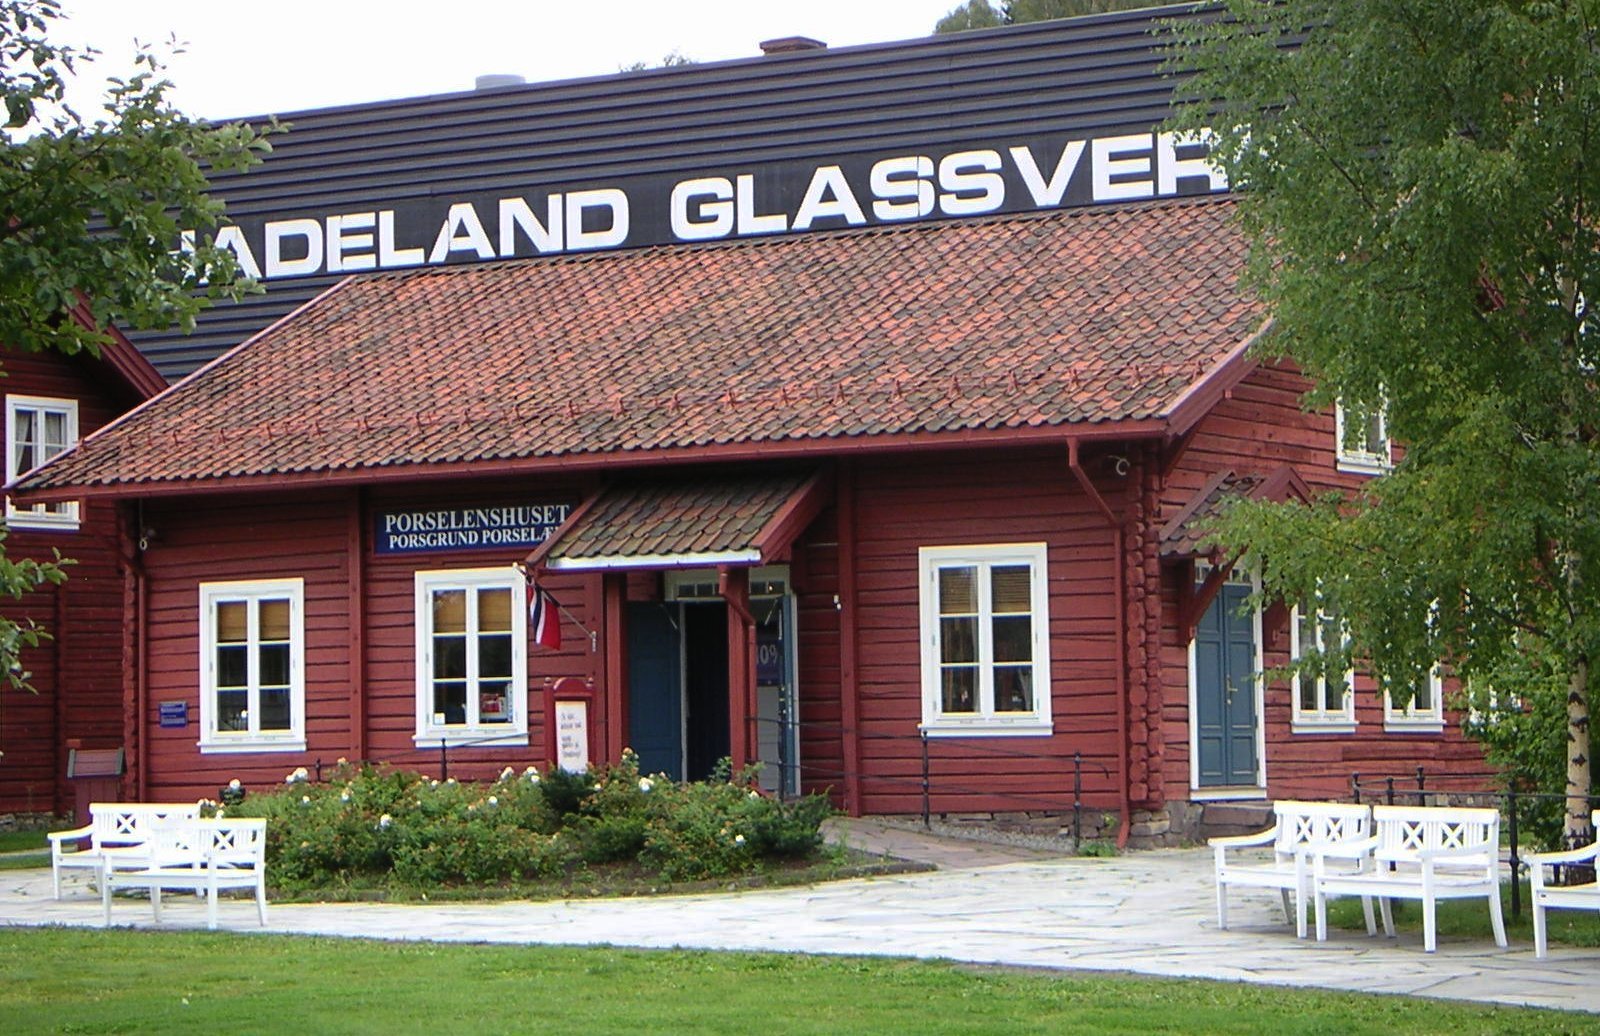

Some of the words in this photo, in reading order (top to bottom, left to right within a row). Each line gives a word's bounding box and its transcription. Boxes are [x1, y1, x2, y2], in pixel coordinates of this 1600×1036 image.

[670, 125, 1250, 242] GLASSVER
[384, 505, 570, 533] PORSELENSHUSET
[389, 530, 479, 549] PORSGRUND
[482, 526, 560, 544] PORSELÆ
